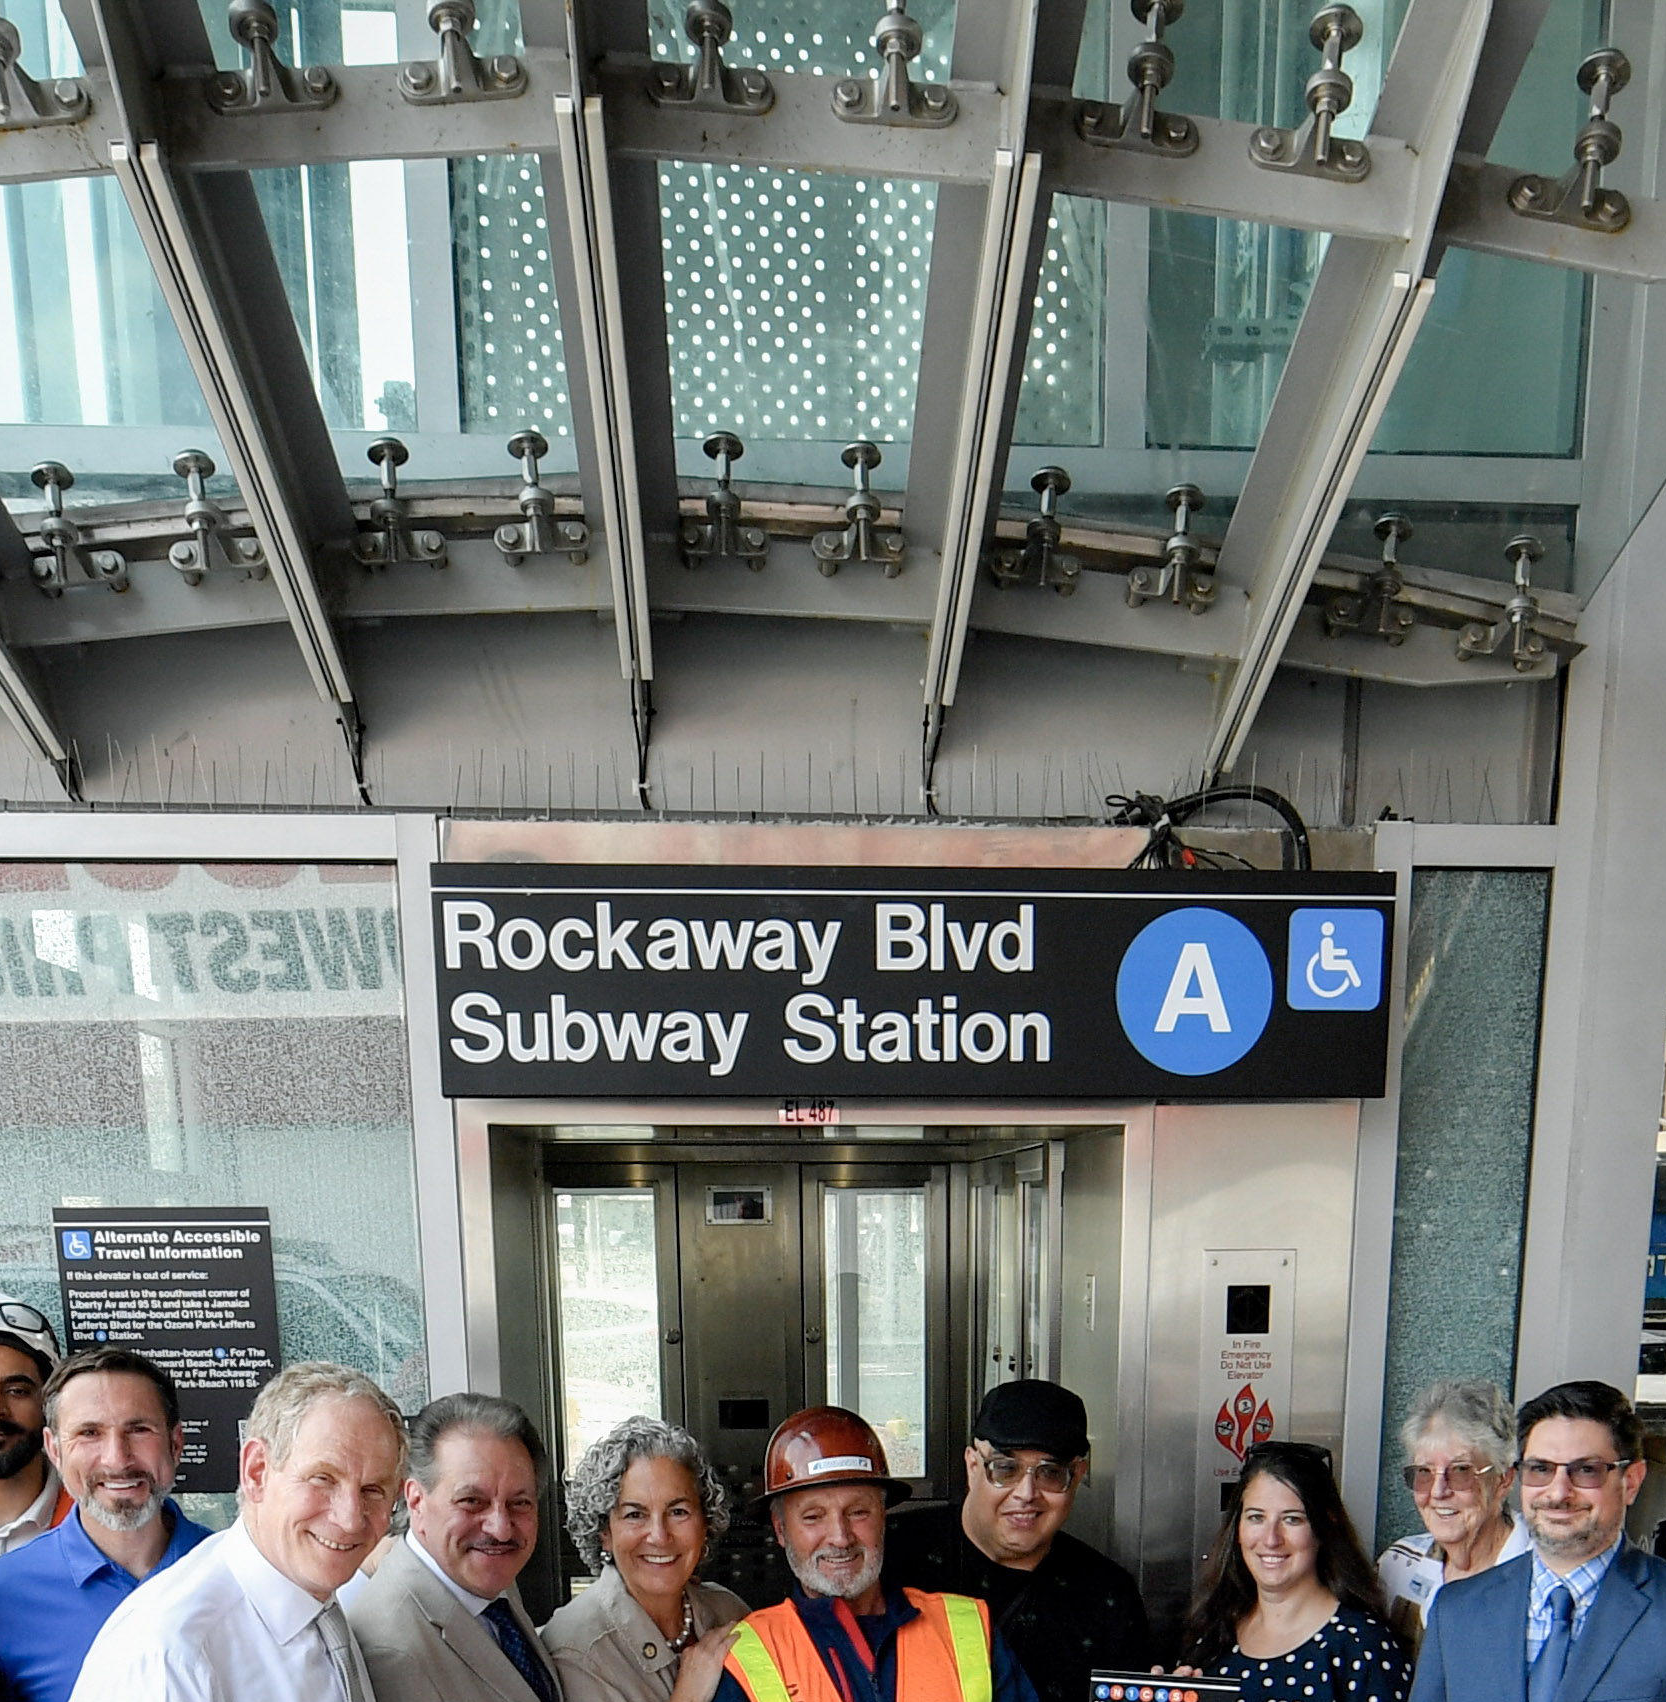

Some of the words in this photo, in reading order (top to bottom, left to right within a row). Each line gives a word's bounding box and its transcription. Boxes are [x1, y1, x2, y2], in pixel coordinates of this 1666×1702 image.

[442, 901, 842, 985] Rockaway
[876, 903, 1035, 972] Blvd
[1154, 943, 1232, 1033] A
[449, 991, 749, 1077] Subway
[782, 991, 1053, 1065] Station
[785, 1099, 805, 1122] EL
[809, 1099, 835, 1122] 487
[93, 1230, 170, 1244] Alternate
[172, 1229, 261, 1244] Accessible
[95, 1246, 146, 1260] Travel
[149, 1246, 244, 1260] Information
[75, 1271, 93, 1280] this
[94, 1271, 131, 1280] elevator
[133, 1271, 142, 1280] is
[143, 1271, 159, 1280] out
[160, 1271, 170, 1280] of
[172, 1270, 209, 1280] service:
[68, 1289, 108, 1299] Proceed
[109, 1289, 129, 1298] east
[130, 1289, 141, 1298] to
[141, 1289, 157, 1298] the
[158, 1289, 207, 1298] southwest
[208, 1289, 239, 1298] corner
[240, 1288, 250, 1298] of
[70, 1299, 103, 1311] Liberty
[104, 1300, 117, 1309] Av
[118, 1300, 136, 1309] and
[151, 1300, 161, 1309] St
[163, 1300, 181, 1308] and
[182, 1299, 202, 1308] take
[211, 1299, 250, 1309] Jamaica
[181, 1309, 205, 1319] Q112
[205, 1310, 223, 1319] bus
[224, 1310, 235, 1319] to
[72, 1320, 109, 1330] Lefferts
[109, 1320, 131, 1330] Blvd
[132, 1320, 146, 1330] for
[147, 1320, 162, 1330] the
[164, 1319, 195, 1330] Ozone
[195, 1319, 256, 1329] Park-Lefferts
[72, 1331, 95, 1341] Blvd
[108, 1330, 145, 1340] Station.
[1232, 1340, 1242, 1349] In
[1243, 1340, 1261, 1349] Fire
[230, 1348, 246, 1358] For
[246, 1347, 266, 1358] The
[1220, 1350, 1272, 1361] Emergency
[185, 1358, 237, 1368] Beach-JFK
[238, 1358, 275, 1369] Airport,
[1220, 1361, 1233, 1370] Do
[1235, 1361, 1253, 1370] Not
[1254, 1361, 1272, 1370] Use
[170, 1369, 183, 1378] for
[192, 1369, 207, 1378] Far
[209, 1369, 260, 1380] Rockaway-
[1227, 1371, 1264, 1380] Elevator
[174, 1379, 228, 1389] Park-Beach
[229, 1379, 245, 1388] 116
